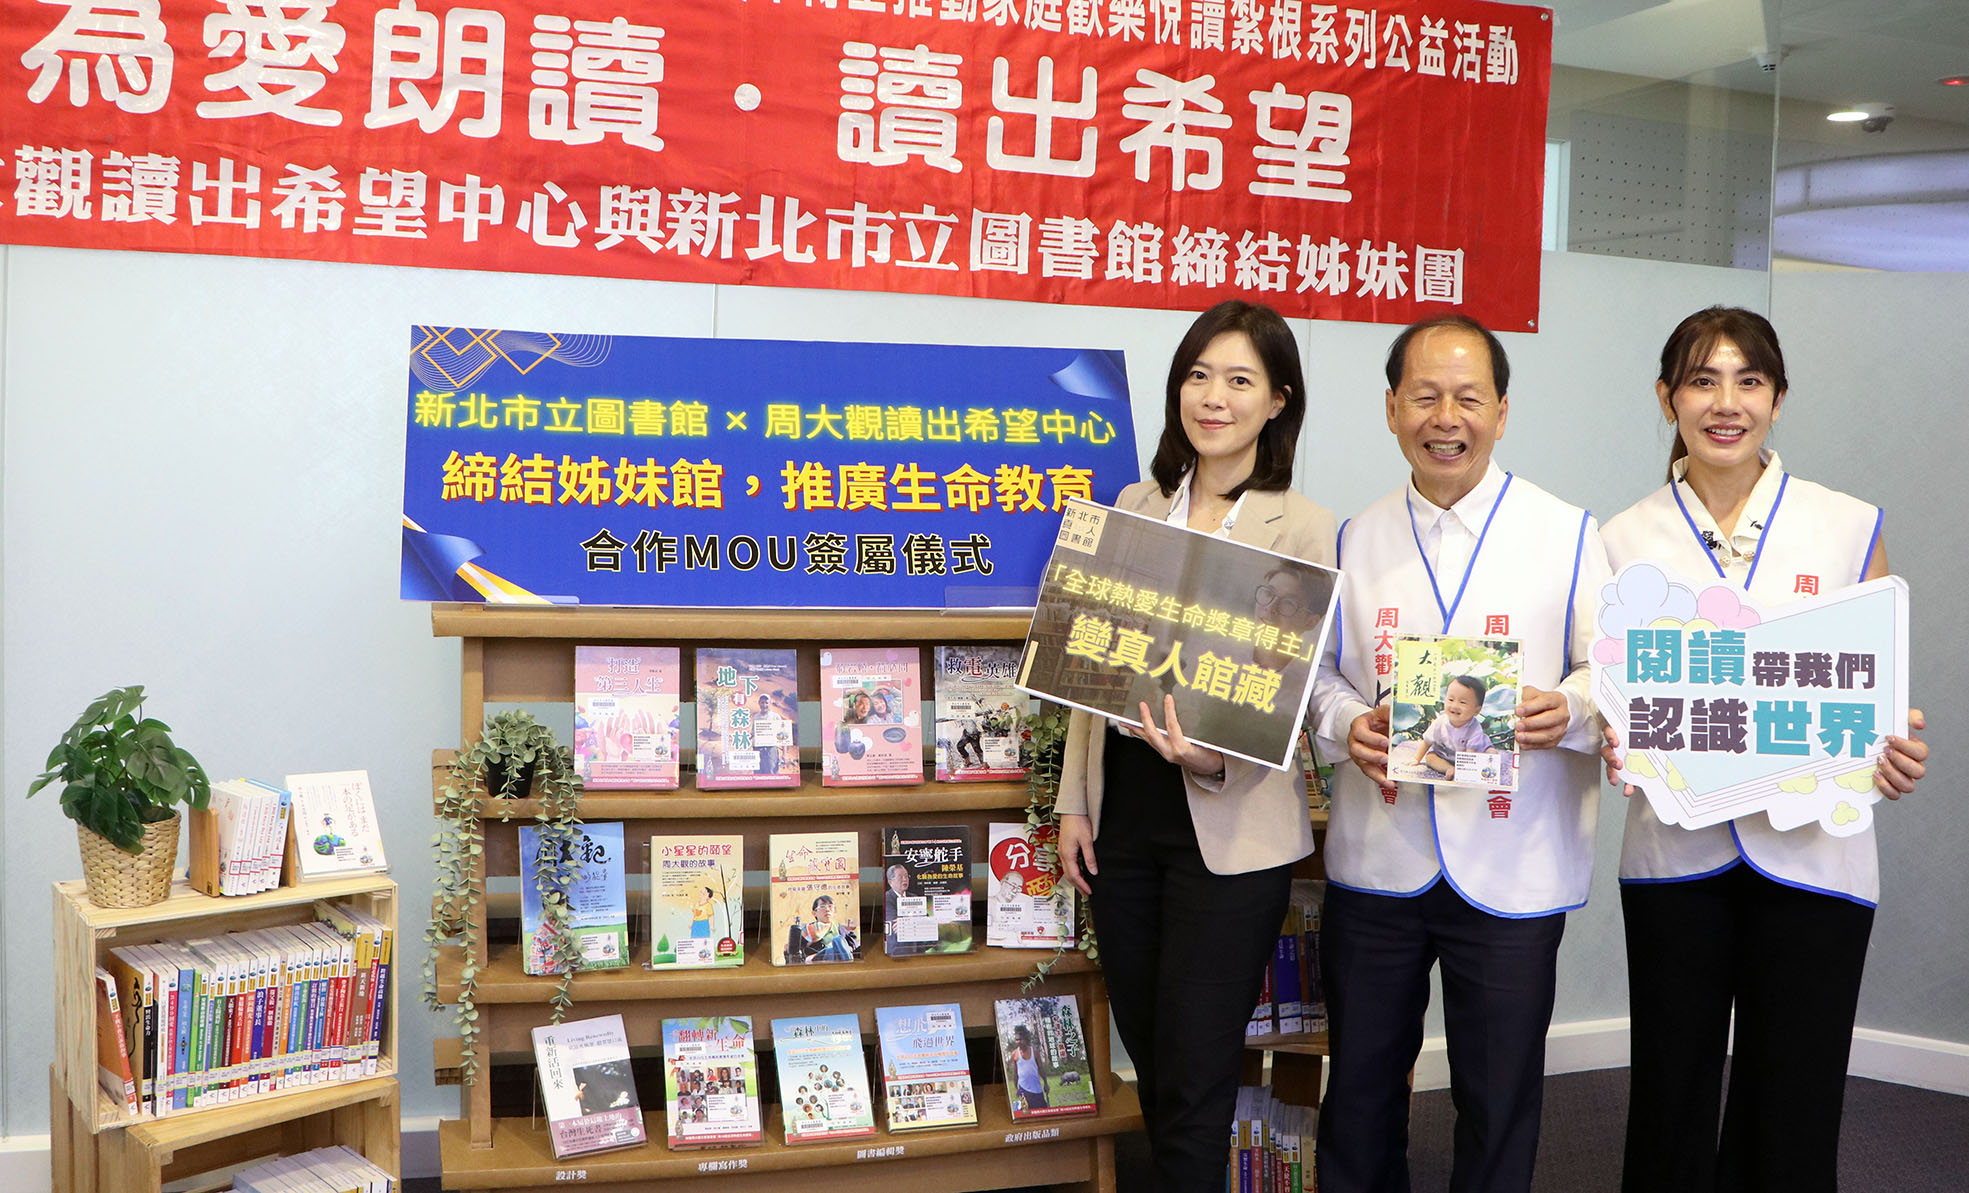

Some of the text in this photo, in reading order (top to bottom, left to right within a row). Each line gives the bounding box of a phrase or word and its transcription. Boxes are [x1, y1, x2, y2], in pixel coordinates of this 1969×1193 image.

[740, 0, 1518, 86] 庭歡樂悅讀紮根系列公益活動
[414, 390, 710, 438] 新北市立圖書館
[765, 403, 1117, 446] 周大觀讀出希望中心
[1066, 507, 1101, 525] 新北市
[580, 529, 996, 577] 合作MOU簽屬儀式
[1794, 574, 1820, 596] 周
[1484, 614, 1510, 636] 周
[1065, 614, 1283, 714] 變真人館藏
[1625, 629, 1876, 691] 閱讀帶我們
[1627, 696, 1880, 759] 認識世界
[904, 846, 964, 866] 安寧舵手
[555, 1169, 588, 1181] 設計獎
